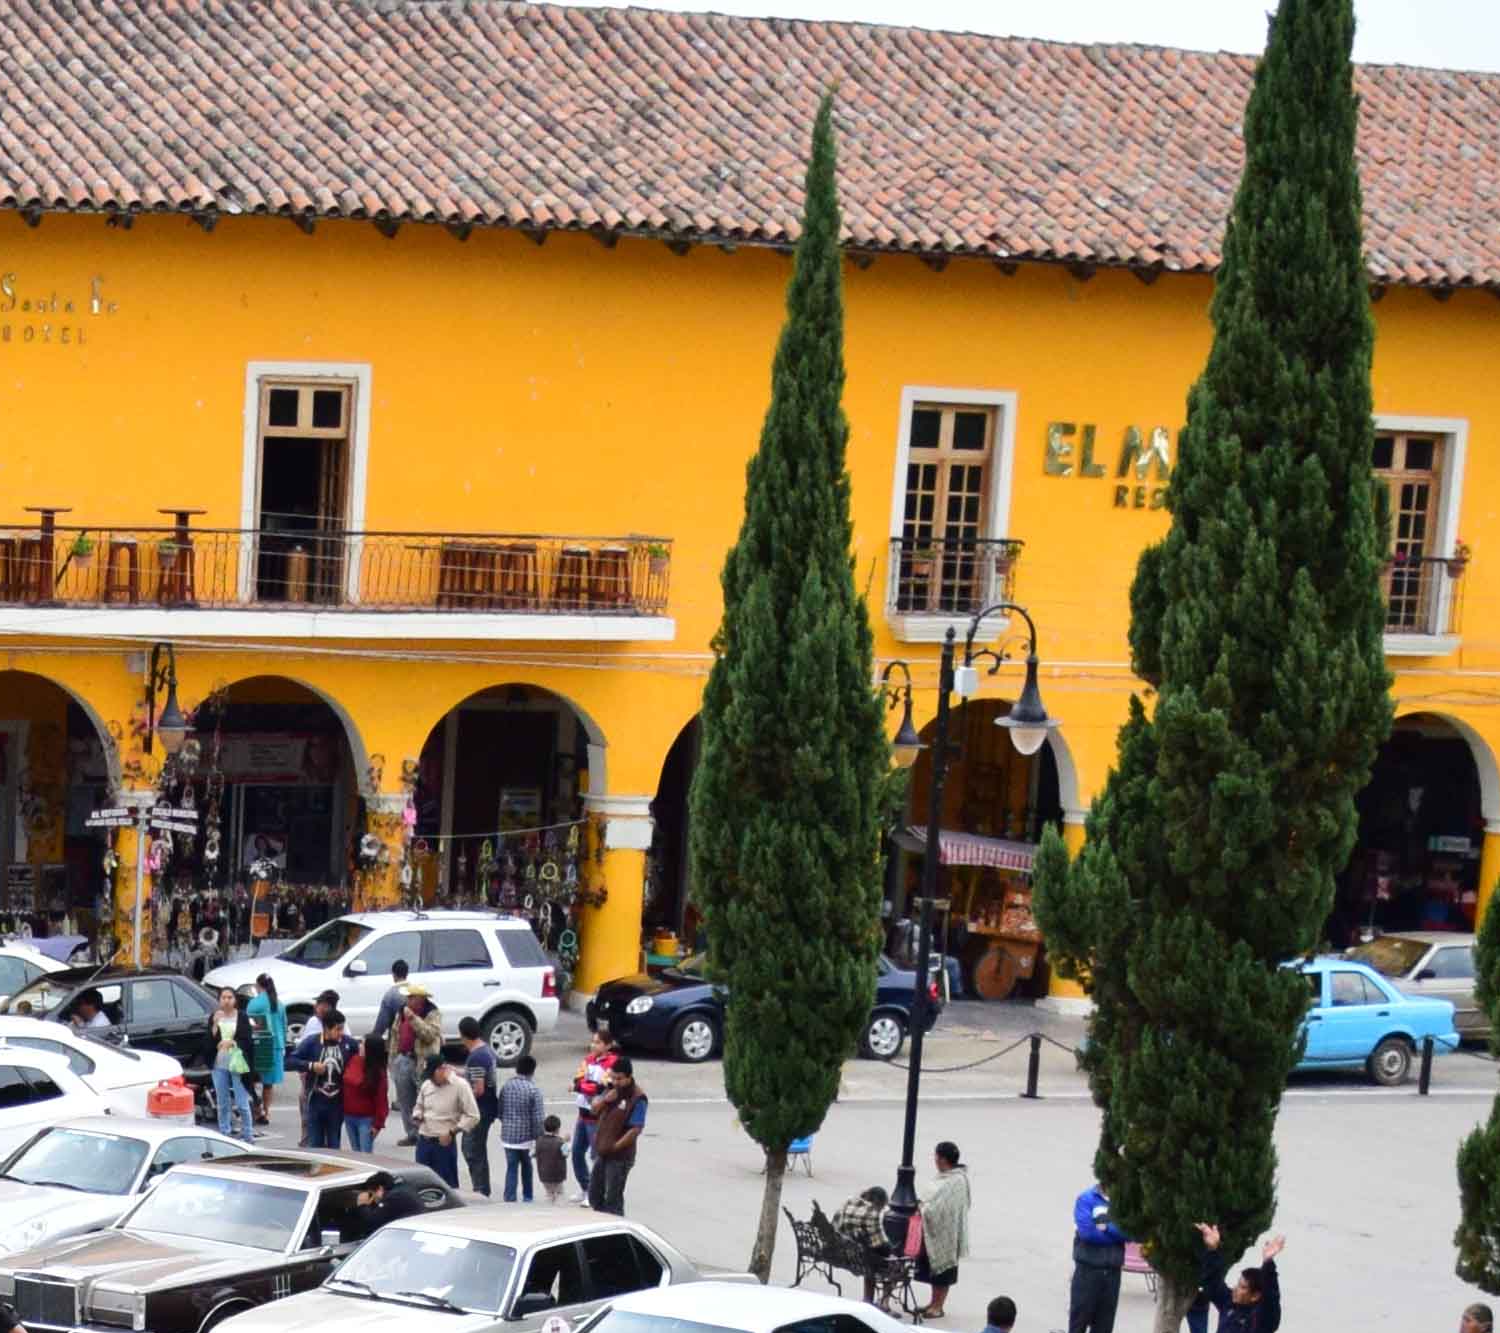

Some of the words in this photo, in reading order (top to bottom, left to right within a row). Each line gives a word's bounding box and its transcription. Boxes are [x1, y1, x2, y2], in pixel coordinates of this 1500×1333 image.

[0, 272, 75, 313] Santa
[2, 324, 88, 345] HOTEL
[1043, 422, 1107, 478] EL
